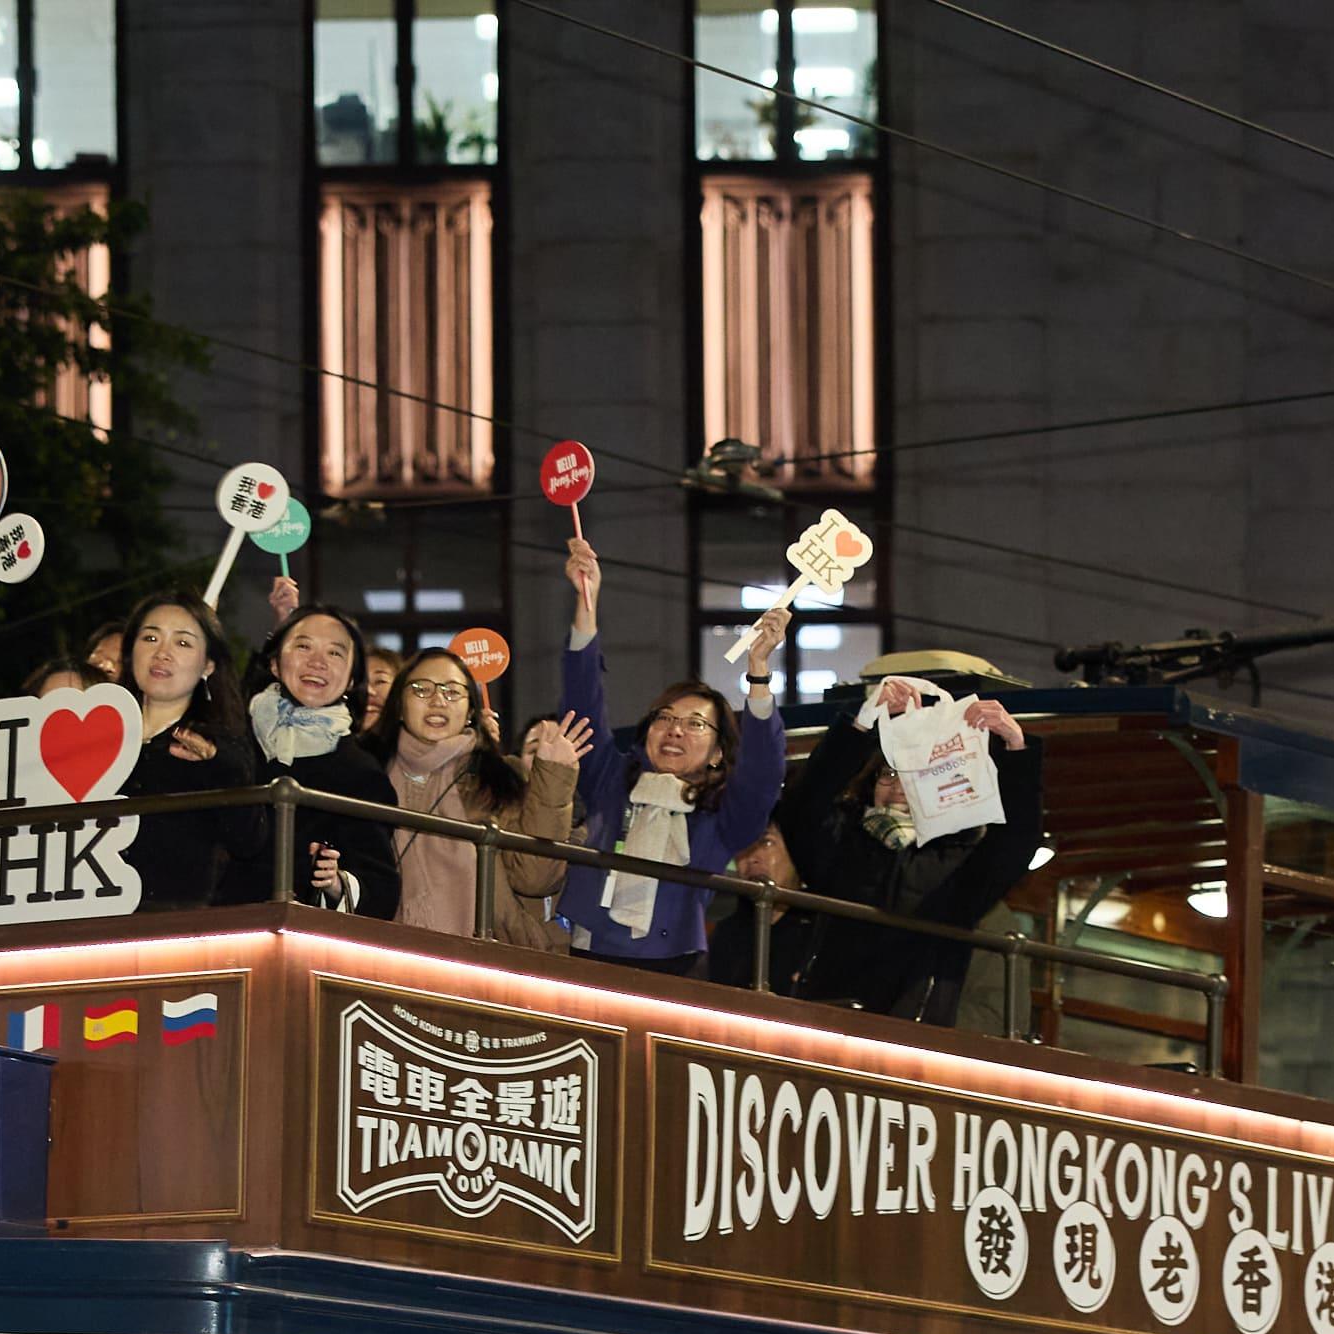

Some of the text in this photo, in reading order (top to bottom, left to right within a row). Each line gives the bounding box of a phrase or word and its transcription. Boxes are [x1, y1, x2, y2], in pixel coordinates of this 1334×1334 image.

[230, 493, 267, 519] 香港
[238, 476, 257, 495] 我
[815, 518, 839, 542] I
[796, 539, 844, 586] HK
[392, 1004, 419, 1026] HONG
[418, 1019, 444, 1038] KONG
[501, 1031, 548, 1048] TRAMWAYS
[357, 1040, 582, 1134] 電車全景遊
[356, 1114, 581, 1207] TRAMORAMIC
[683, 1062, 938, 1242] DISCOVER
[446, 1161, 497, 1194] TOUR
